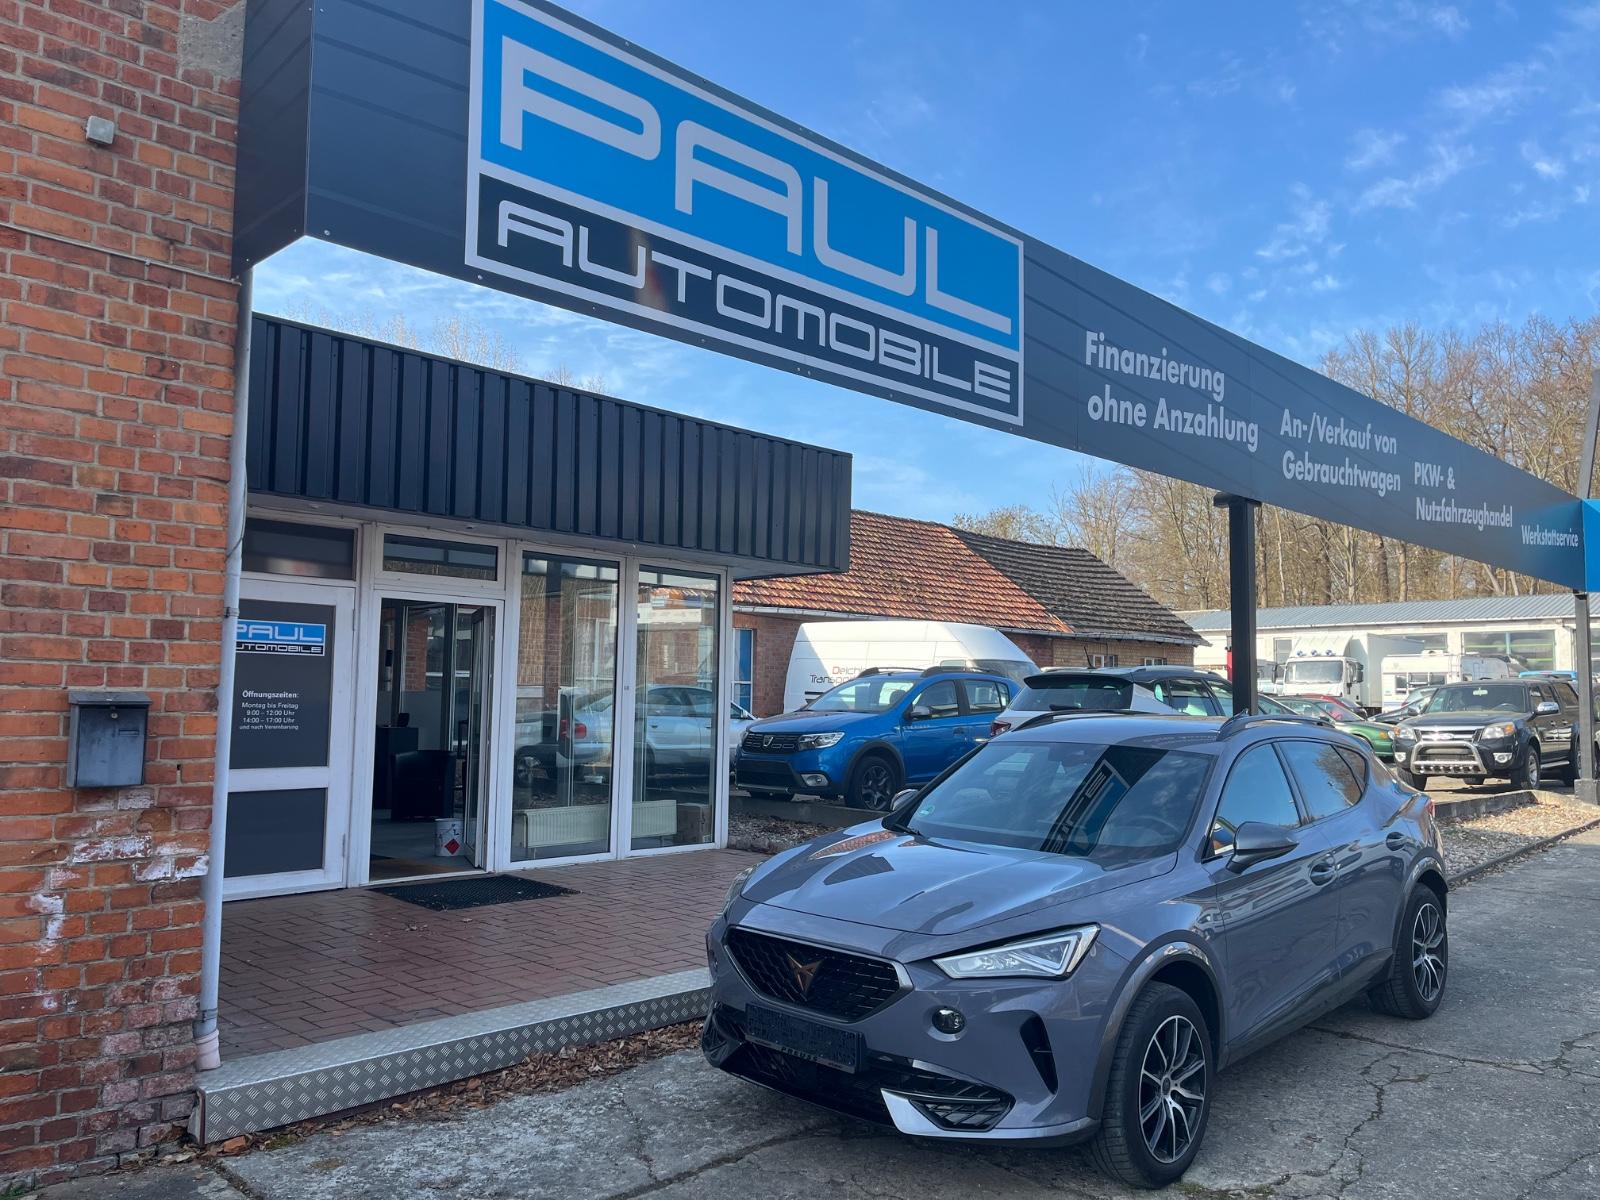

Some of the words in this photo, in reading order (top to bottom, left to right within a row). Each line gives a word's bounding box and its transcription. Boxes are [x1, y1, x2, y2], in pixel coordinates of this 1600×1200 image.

[500, 35, 1011, 335] PAUL
[498, 200, 1010, 403] AUTOMOBILE
[1086, 330, 1225, 402] Finanzierung
[1087, 384, 1147, 427] ohne
[1153, 397, 1258, 453] Anzahlung
[1280, 408, 1371, 450] An-/Verkauf
[1374, 434, 1397, 455] von
[1282, 450, 1401, 497] Gebrauchtwagen
[1414, 461, 1444, 488] PKW-
[1447, 466, 1456, 490] &
[1416, 496, 1513, 532] Nutzfahrzeughandel
[1521, 524, 1579, 547] Werkstattservice
[236, 643, 321, 653] UTOMOBILE
[810, 674, 855, 685] Transpo
[831, 665, 868, 675] Deichl
[242, 702, 266, 710] Montag
[278, 702, 299, 710] Freitag
